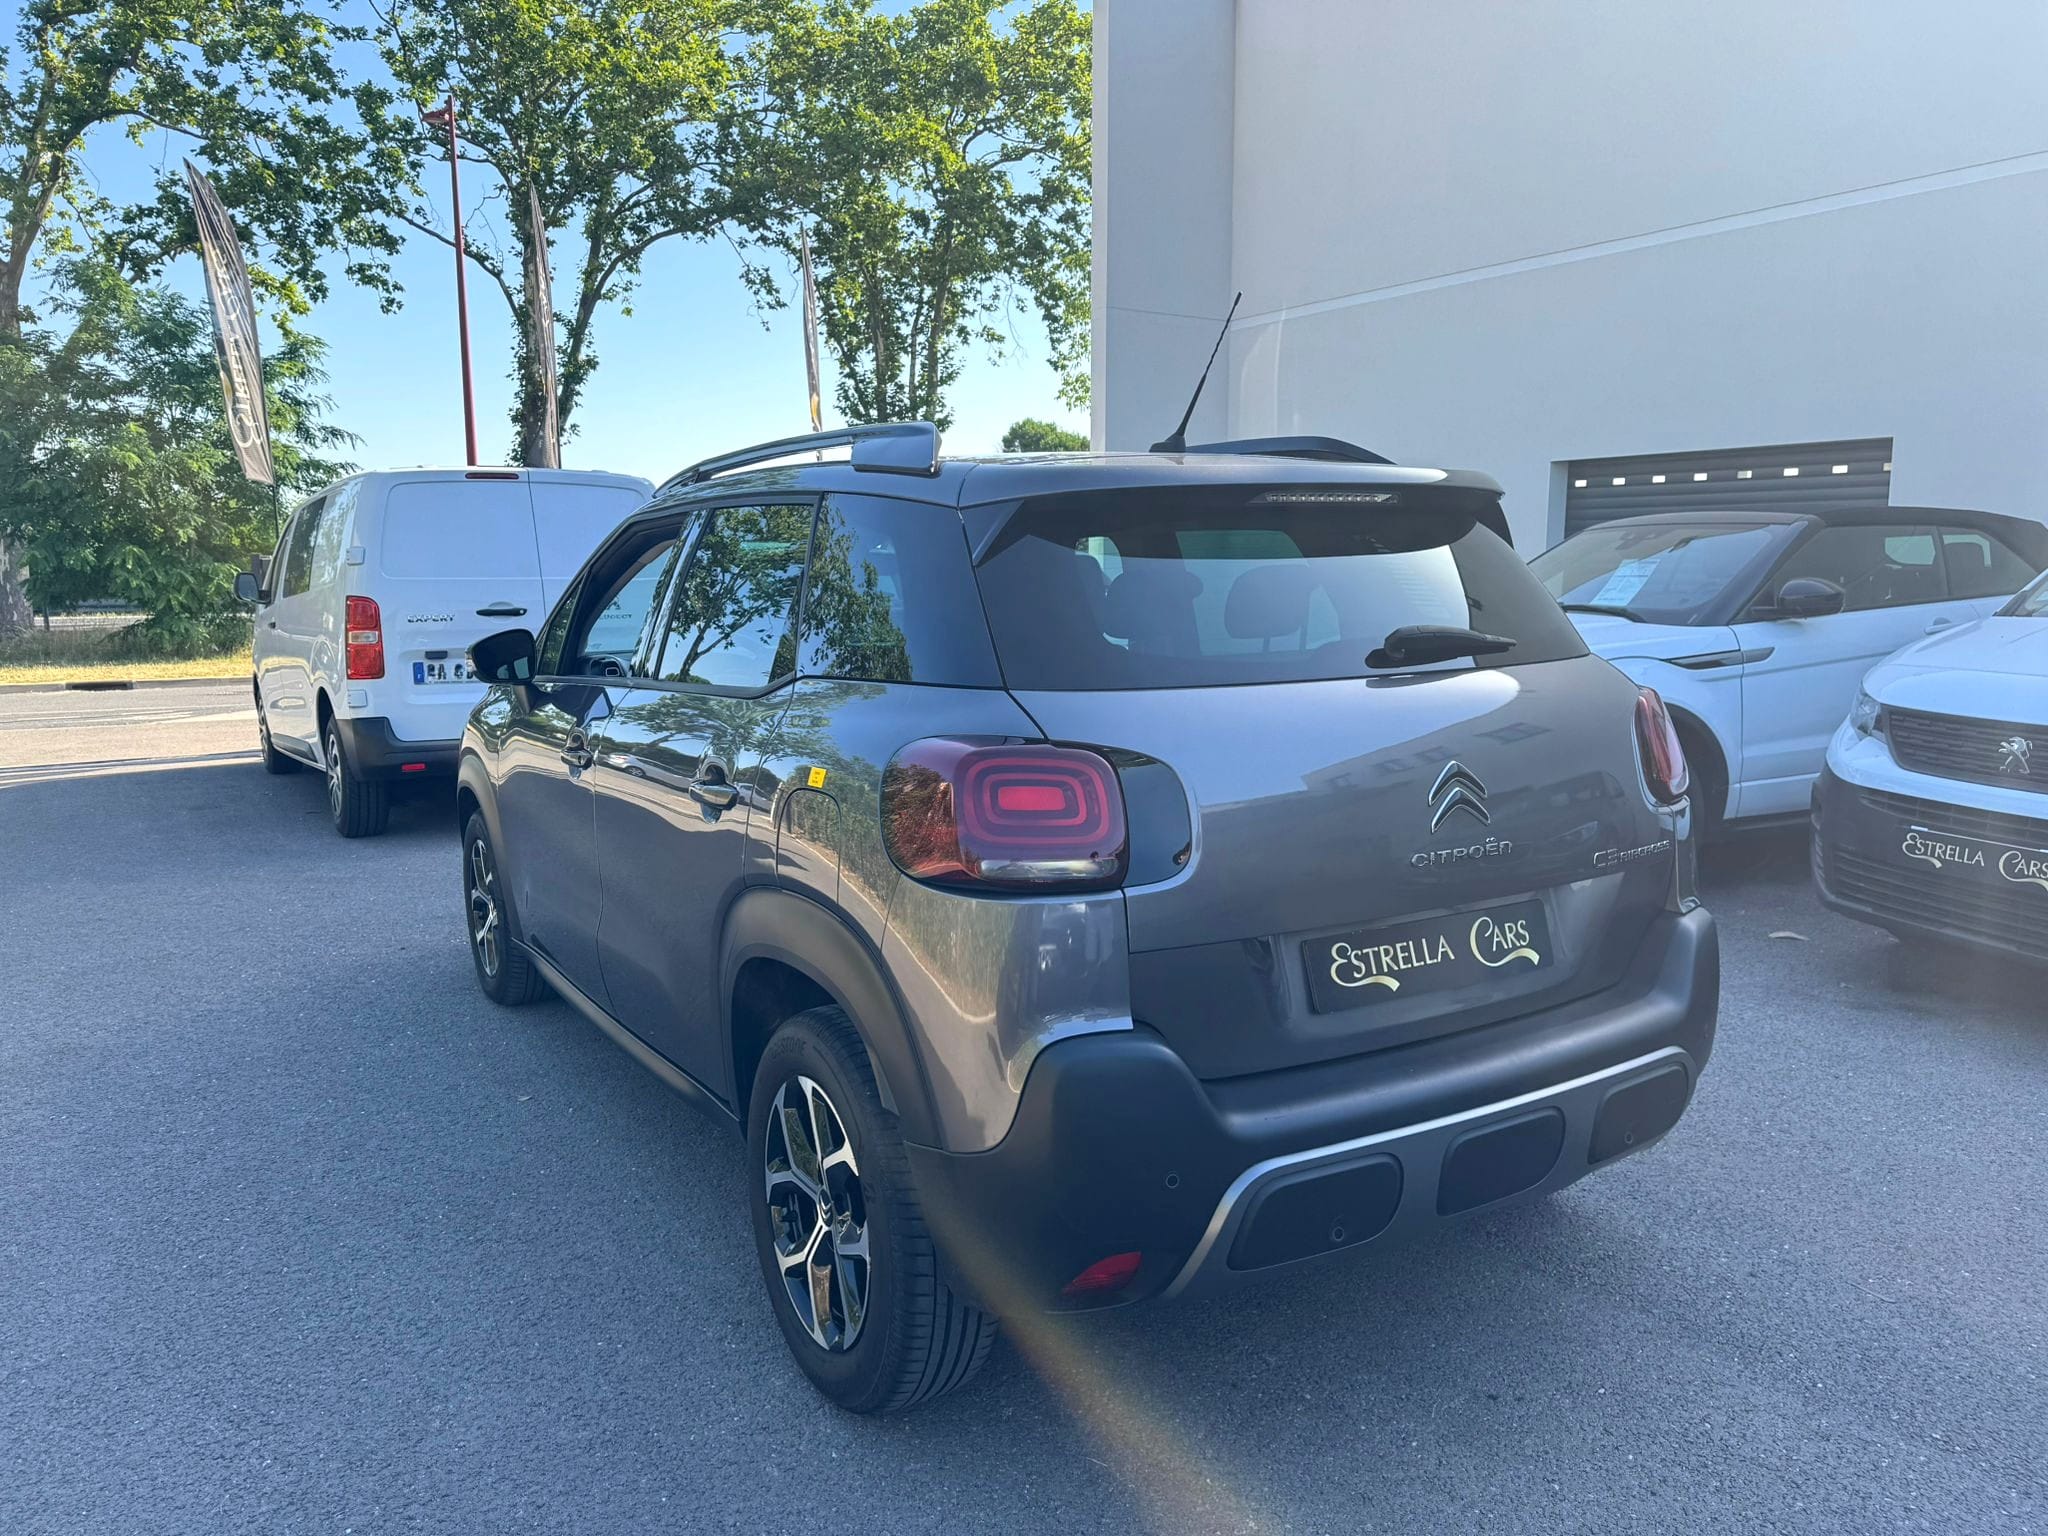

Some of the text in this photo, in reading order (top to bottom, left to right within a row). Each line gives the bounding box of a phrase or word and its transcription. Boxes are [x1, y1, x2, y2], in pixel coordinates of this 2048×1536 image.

[407, 614, 455, 623] EXPERT
[1410, 837, 1513, 868] CITROËN
[1593, 839, 1671, 869] C3 AIRCROSS
[1902, 832, 2048, 890] ESTRELLA CARS
[1330, 916, 1541, 993] ESTRELLA CARS
